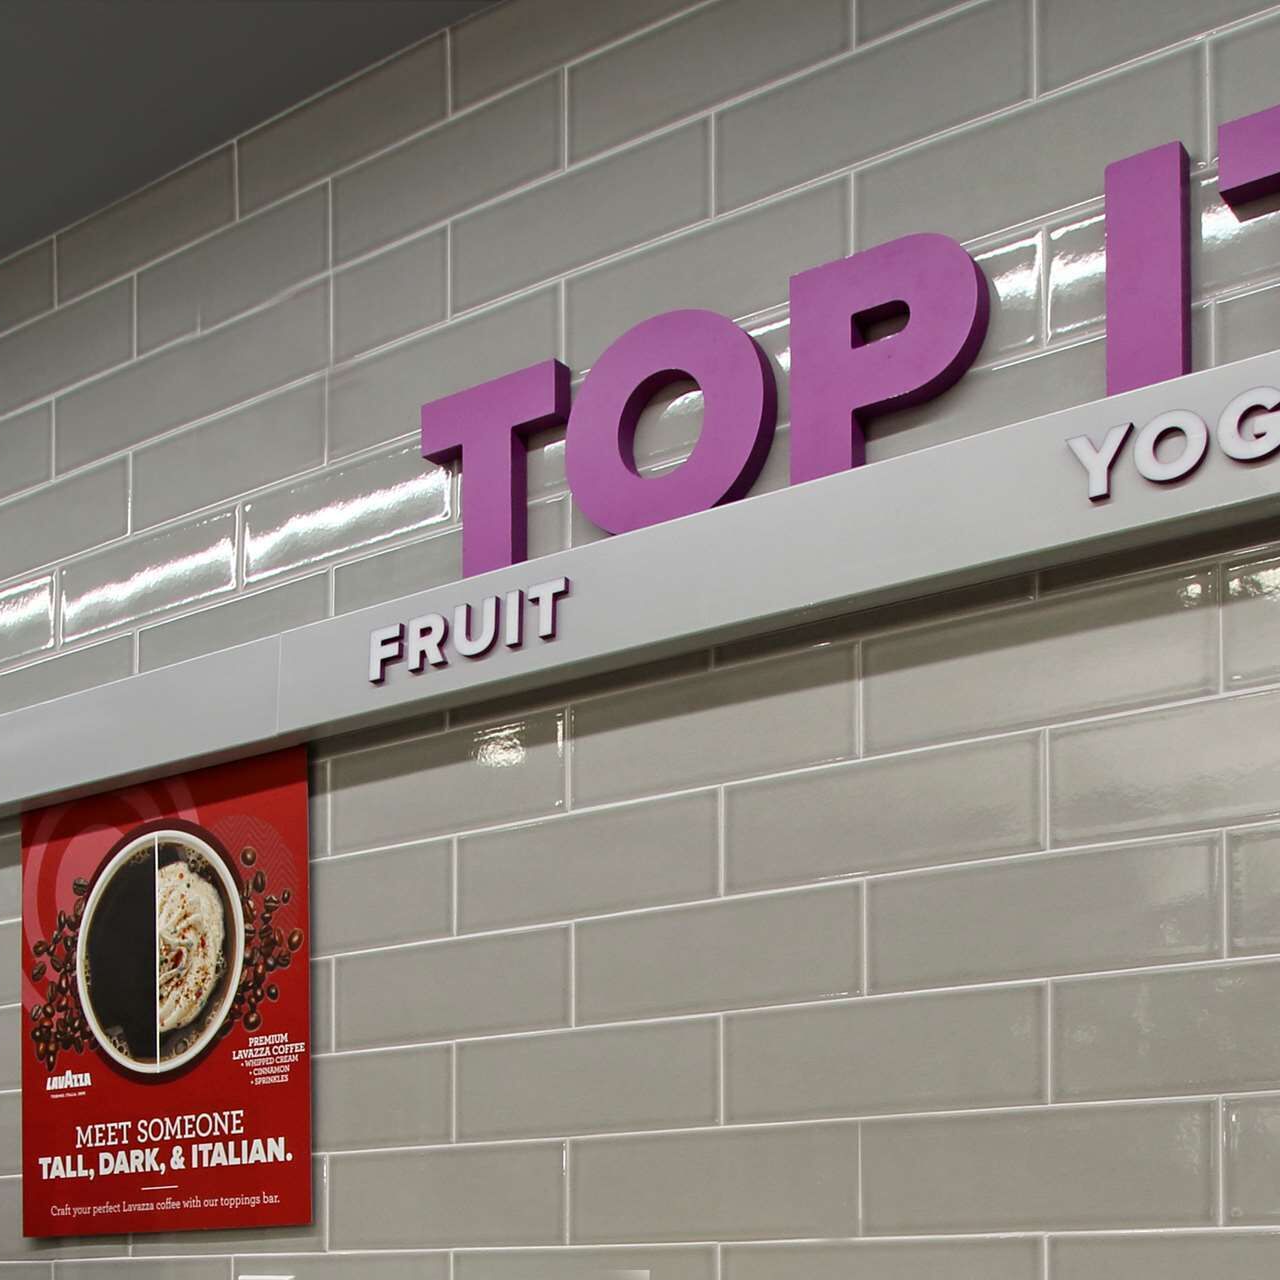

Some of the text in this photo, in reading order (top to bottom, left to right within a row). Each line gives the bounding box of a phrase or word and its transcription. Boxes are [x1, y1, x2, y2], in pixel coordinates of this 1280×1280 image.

[421, 232, 991, 578] TOP
[367, 576, 570, 684] FRUIT
[232, 1042, 305, 1060] LAVAZZA COFFEE
[248, 1033, 289, 1047] PREMIUM
[245, 1054, 299, 1067] WHIPPED CREAM
[253, 1065, 290, 1076] CINNAMON
[46, 1069, 92, 1091] LAVAZZA
[254, 1074, 289, 1086] SPRINKLES
[75, 1109, 244, 1149] MEET SOMEONE
[38, 1136, 293, 1181] TALL, DARK, & ITALIAN.
[51, 1191, 280, 1217] Craft your perfect Lavazza coffee with our toppings bar.
